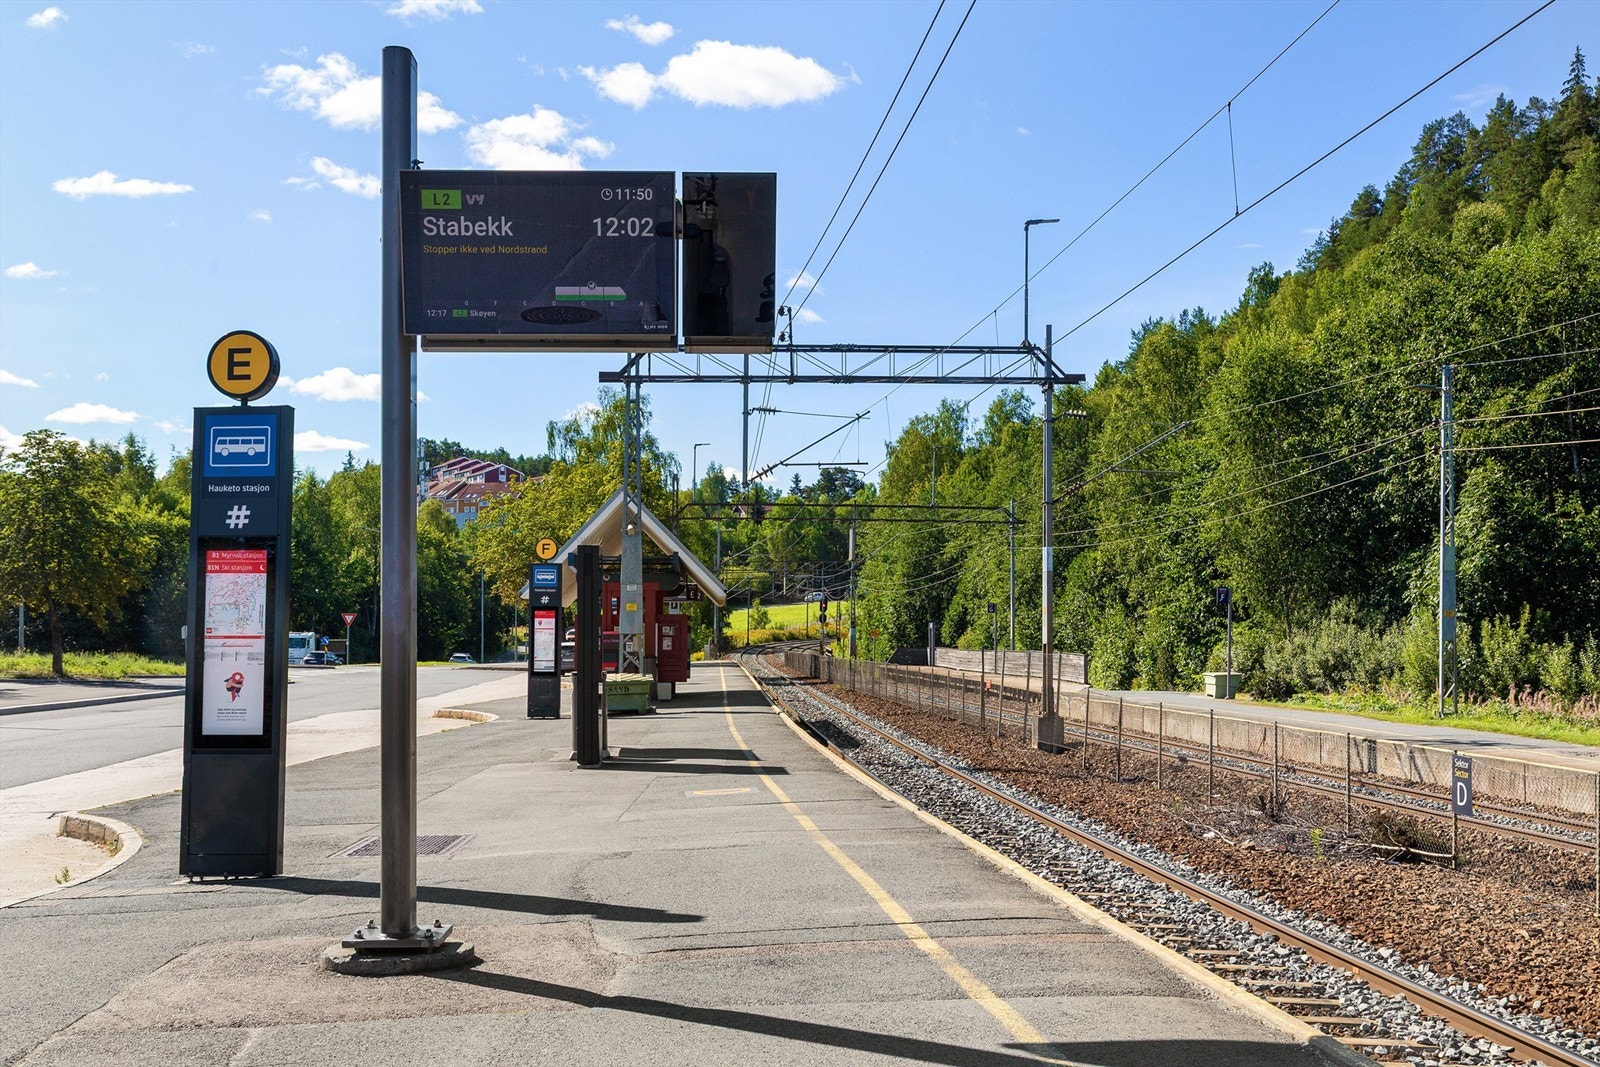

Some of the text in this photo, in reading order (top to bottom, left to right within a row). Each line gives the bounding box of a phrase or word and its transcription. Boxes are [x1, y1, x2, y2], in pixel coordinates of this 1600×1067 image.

[433, 193, 450, 206] L2
[615, 188, 653, 200] 11:50
[423, 216, 514, 236] Stabekk
[592, 217, 654, 237] 12:02
[423, 244, 548, 255] Stopper ikke ved Nordstrand
[426, 309, 447, 317] 12:17
[469, 309, 497, 318] Skøyen
[227, 347, 252, 381] E
[208, 484, 270, 493] Hauketo stasjon
[541, 543, 551, 555] F
[1457, 782, 1467, 806] D
